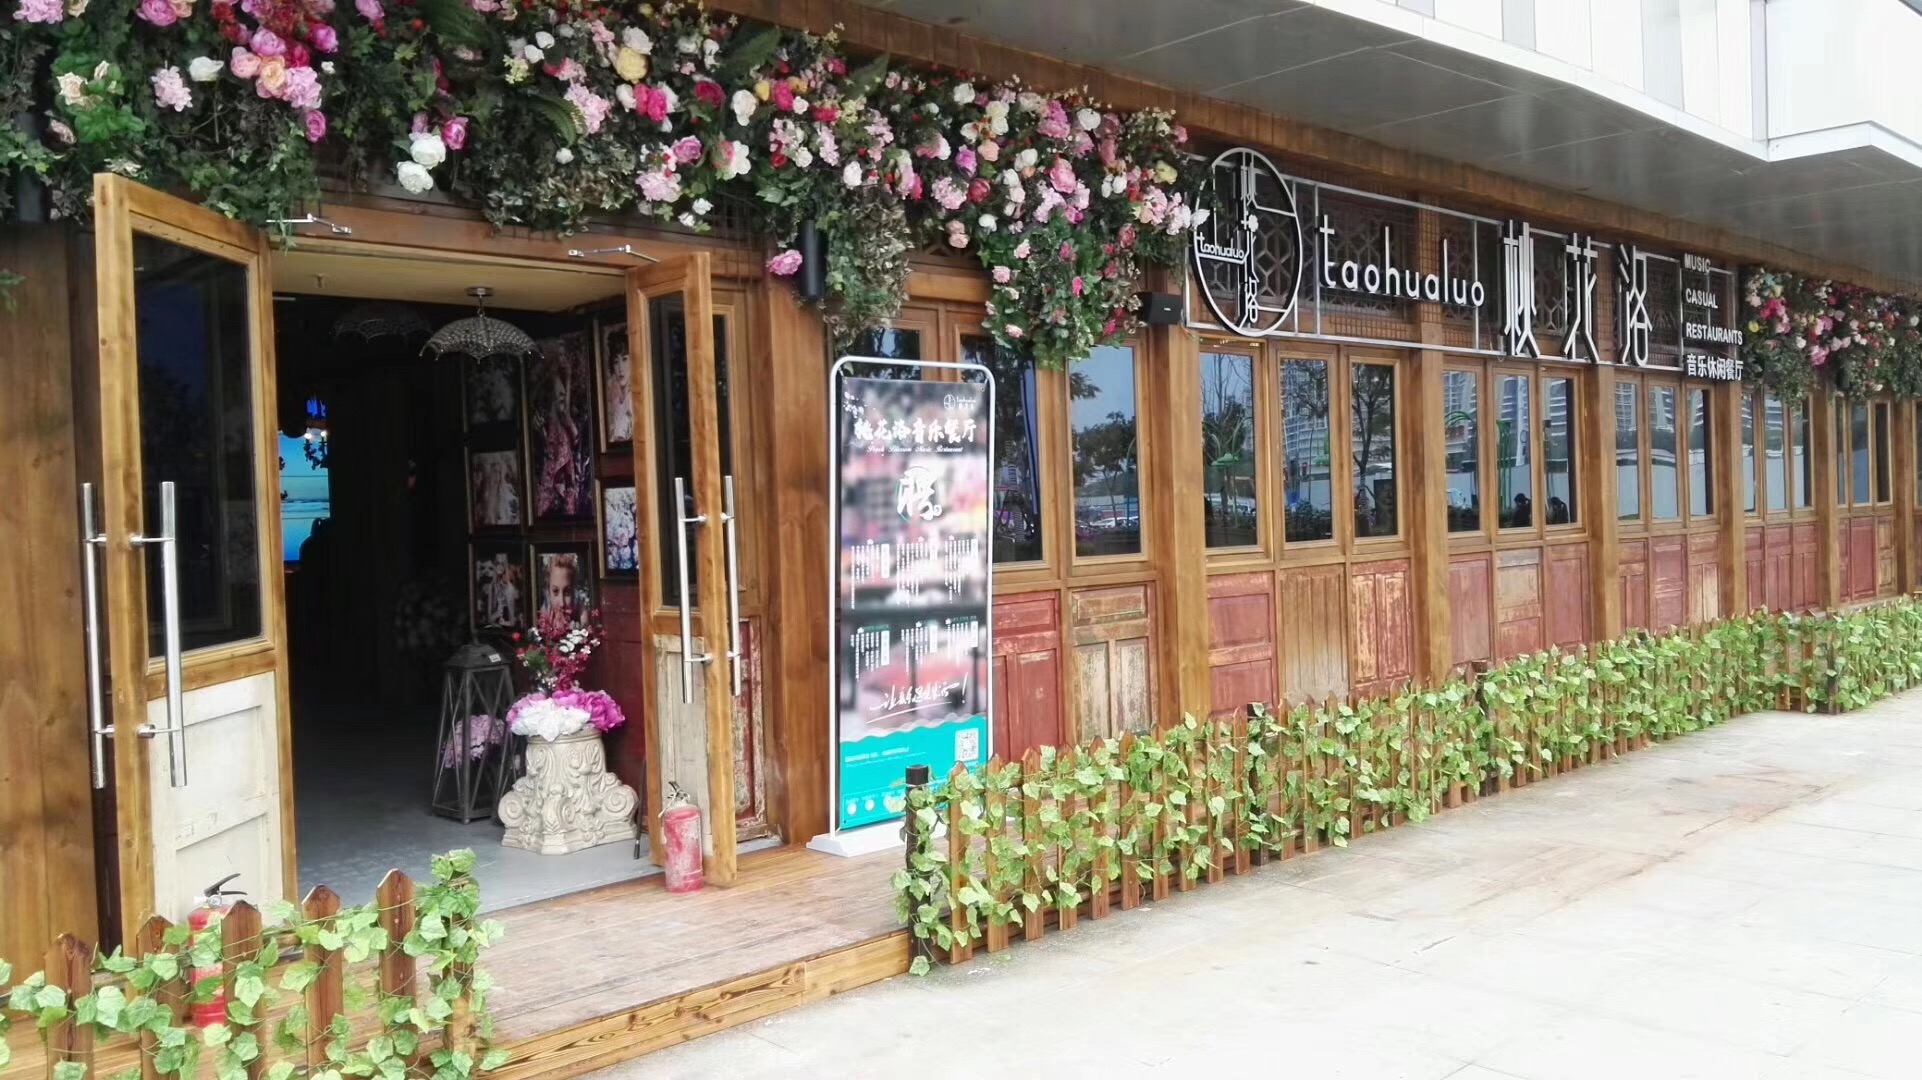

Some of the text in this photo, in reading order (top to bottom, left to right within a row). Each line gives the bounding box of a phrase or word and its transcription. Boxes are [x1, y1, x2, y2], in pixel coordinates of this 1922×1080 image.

[1319, 214, 1485, 307] taohualuo
[1684, 253, 1711, 273] MUSIC
[1685, 287, 1719, 309] CASUAL
[1686, 322, 1743, 346] RESTAURANTS
[1686, 353, 1744, 381] 音乐休闲餐厅
